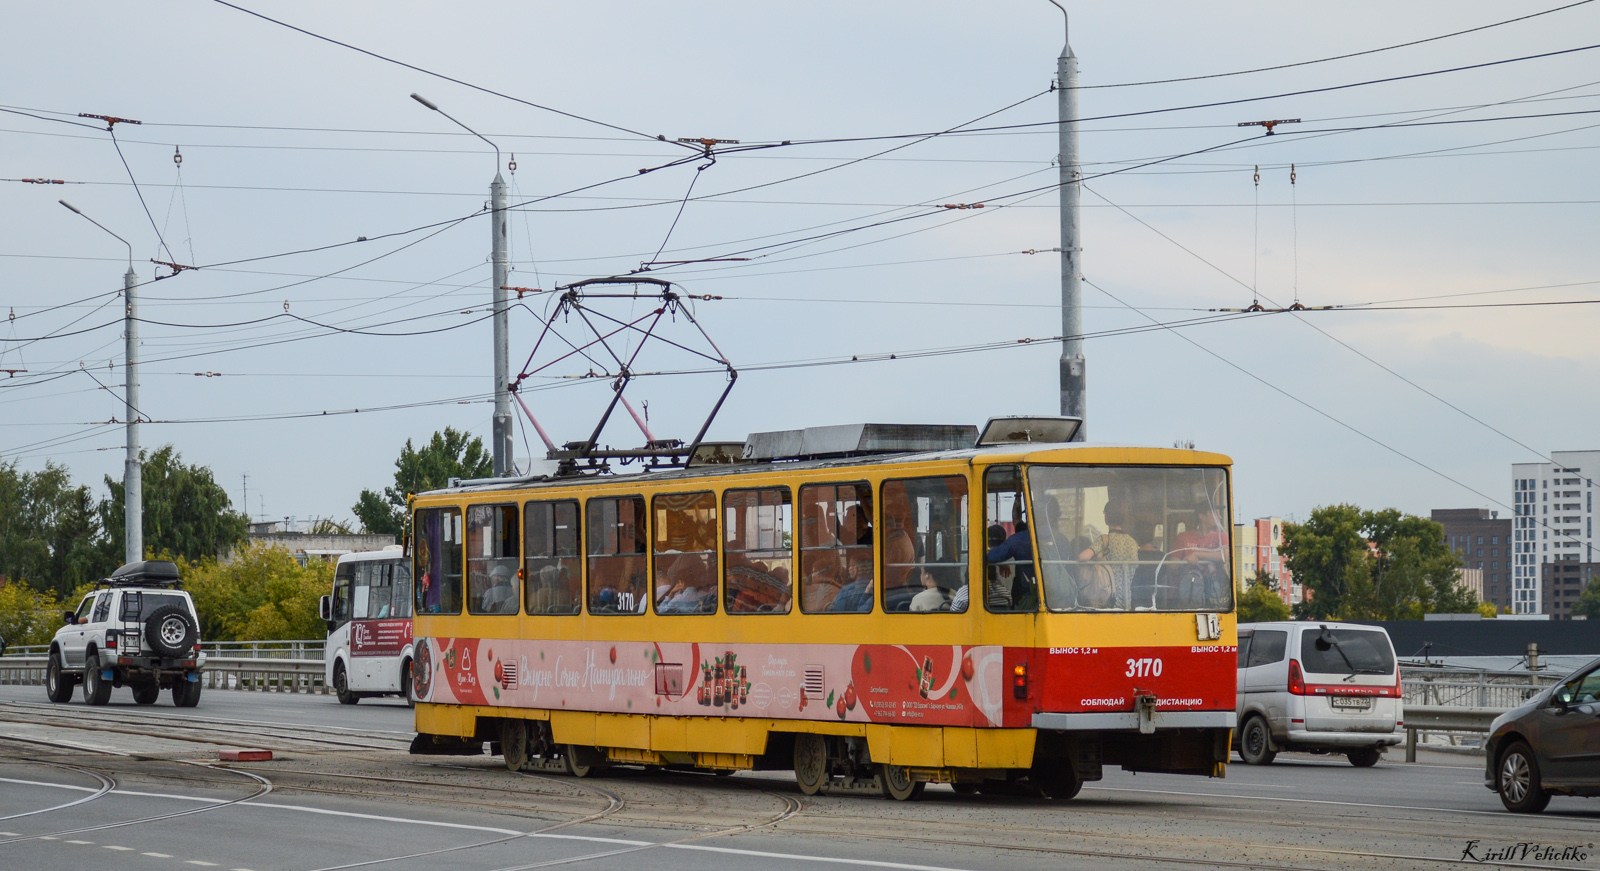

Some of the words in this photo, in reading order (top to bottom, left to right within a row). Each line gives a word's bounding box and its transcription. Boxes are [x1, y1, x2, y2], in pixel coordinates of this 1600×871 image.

[617, 592, 634, 611] 3170
[1210, 620, 1216, 633] 1
[1049, 647, 1079, 655] ВЫНОС
[1081, 647, 1091, 656] 1,2
[1221, 646, 1230, 654] 1,2
[582, 647, 654, 701] Натурально
[1125, 658, 1162, 678] 3170
[1080, 697, 1124, 706] СОБЛЮДАЙ
[1156, 698, 1203, 707] ДИСТАНЦИЮ
